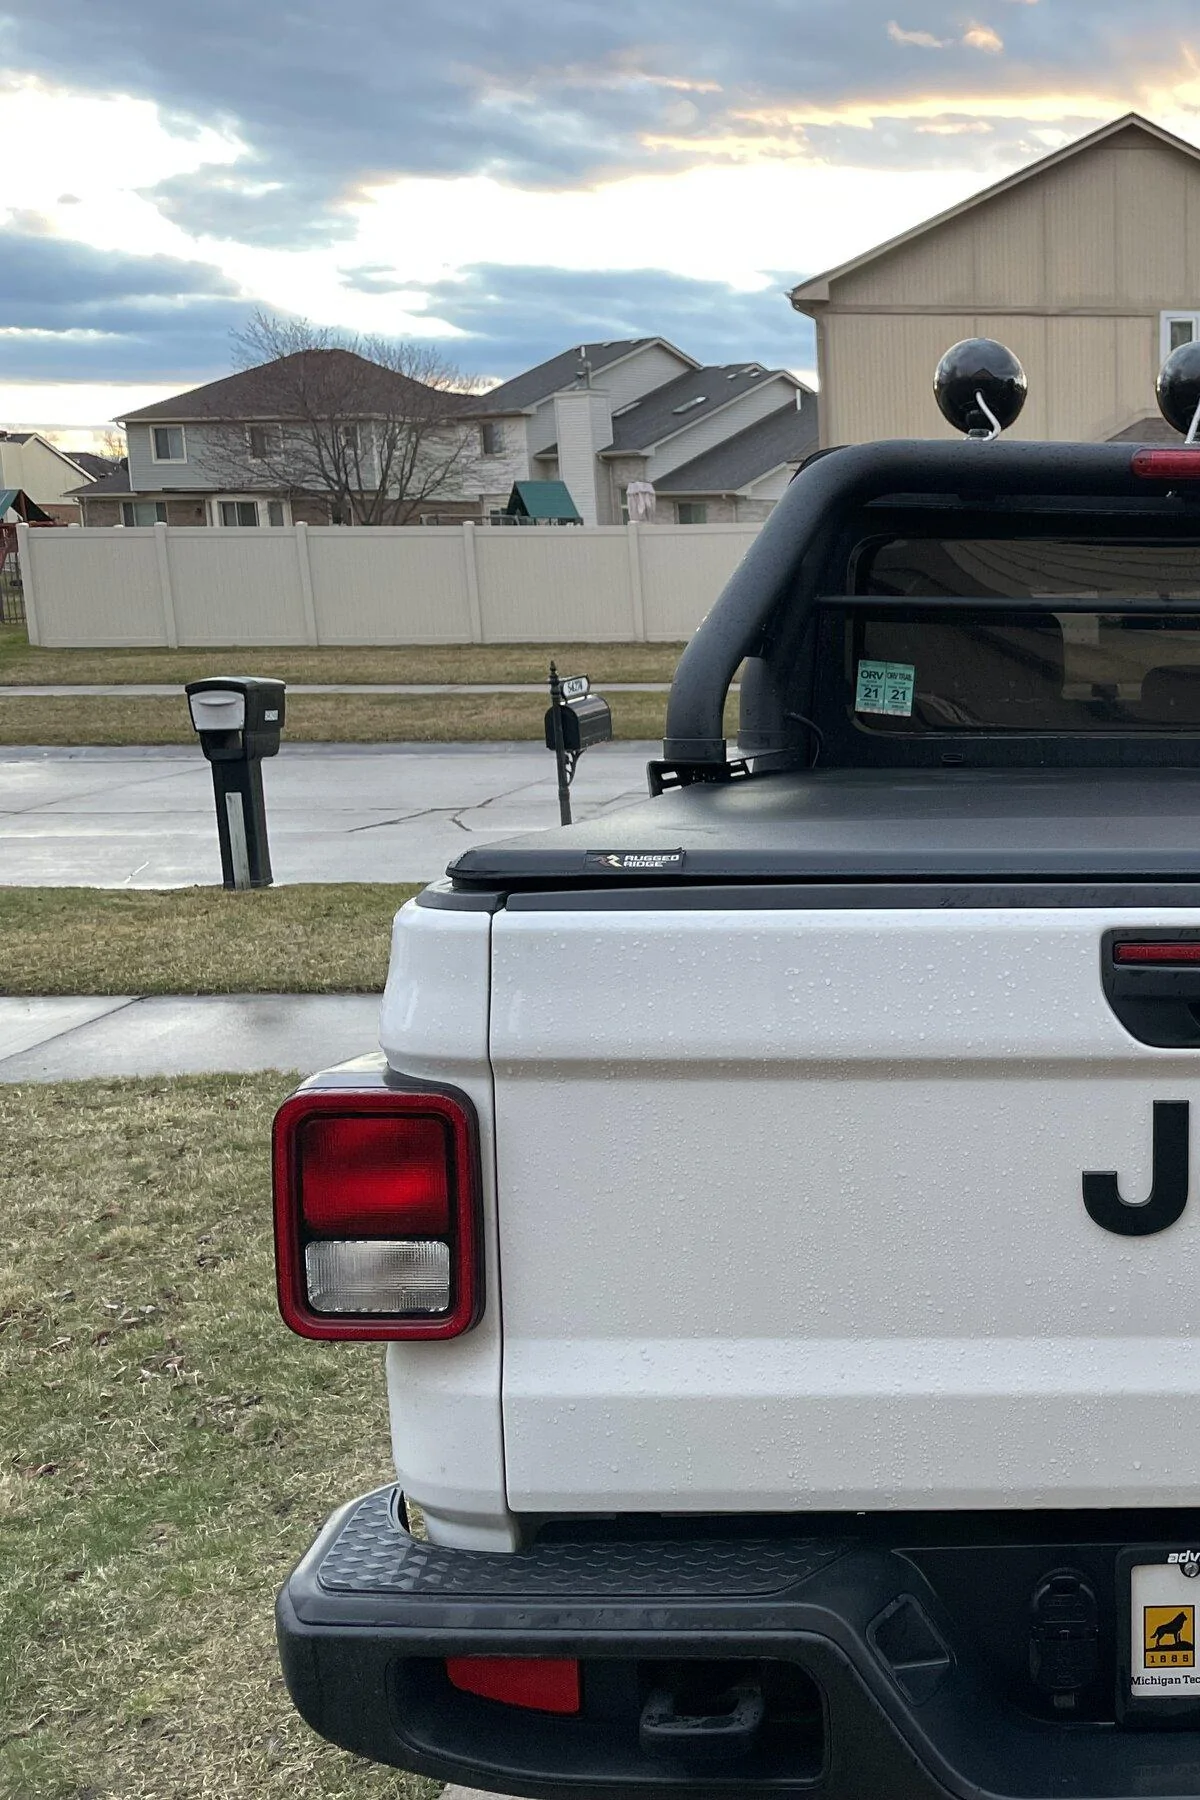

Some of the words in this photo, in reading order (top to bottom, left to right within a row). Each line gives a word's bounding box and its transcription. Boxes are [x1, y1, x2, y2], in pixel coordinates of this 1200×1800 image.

[861, 670, 883, 680] ORV
[863, 687, 878, 698] 21
[891, 689, 906, 700] 21
[1150, 1654, 1190, 1664] 1885
[1131, 1675, 1181, 1687] Michigan
